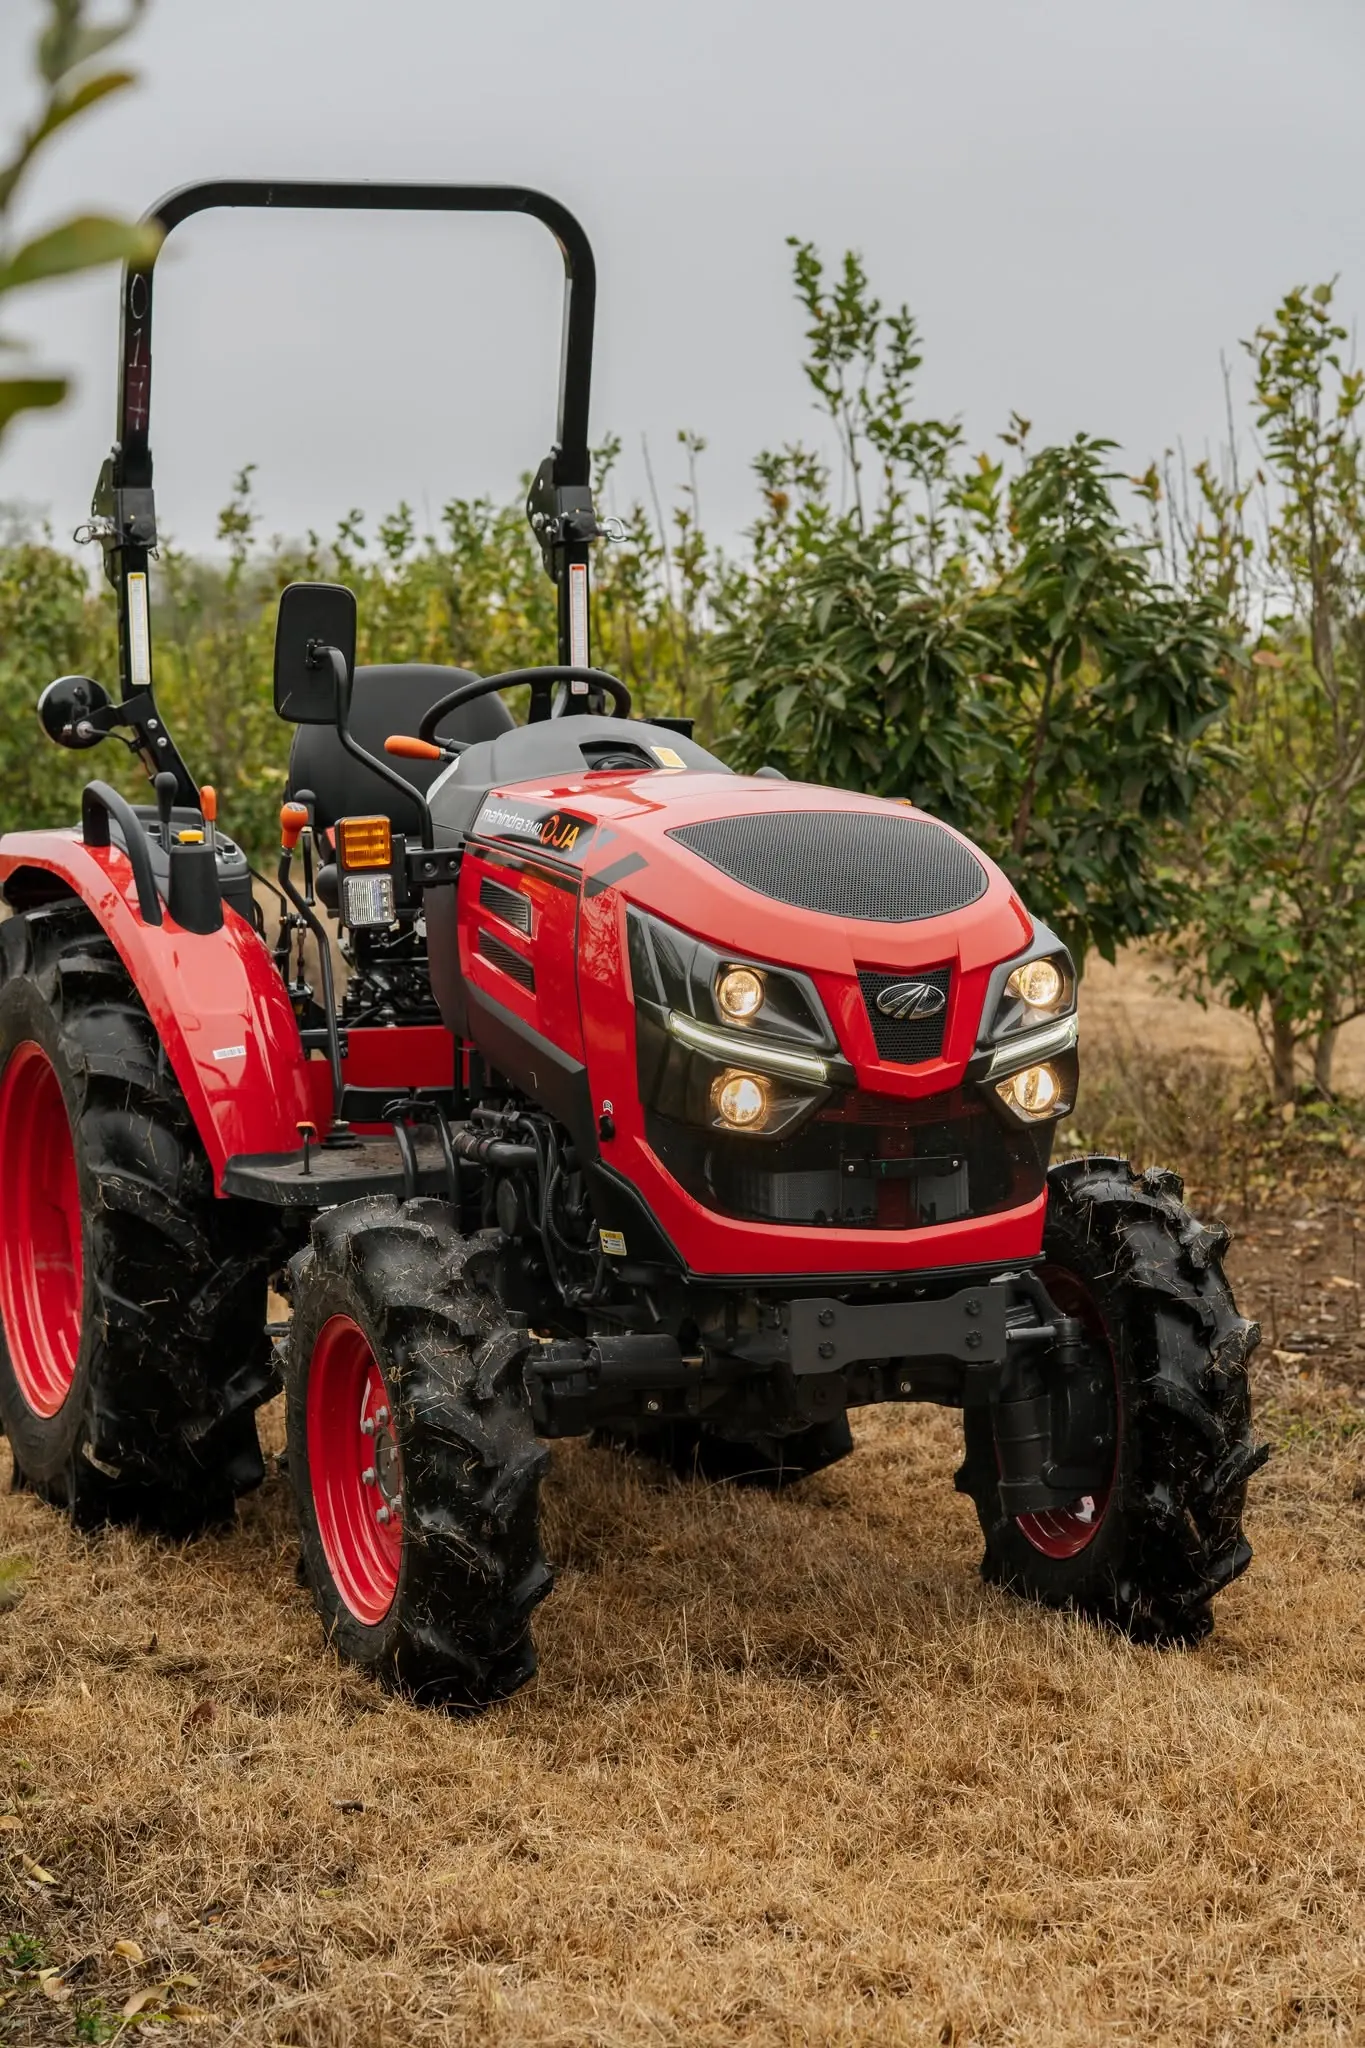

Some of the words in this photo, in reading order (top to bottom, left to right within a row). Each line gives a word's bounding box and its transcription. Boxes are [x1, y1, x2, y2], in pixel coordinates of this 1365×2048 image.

[481, 807, 524, 831] mahindra
[522, 819, 543, 836] 3140
[540, 814, 580, 852] OJA
